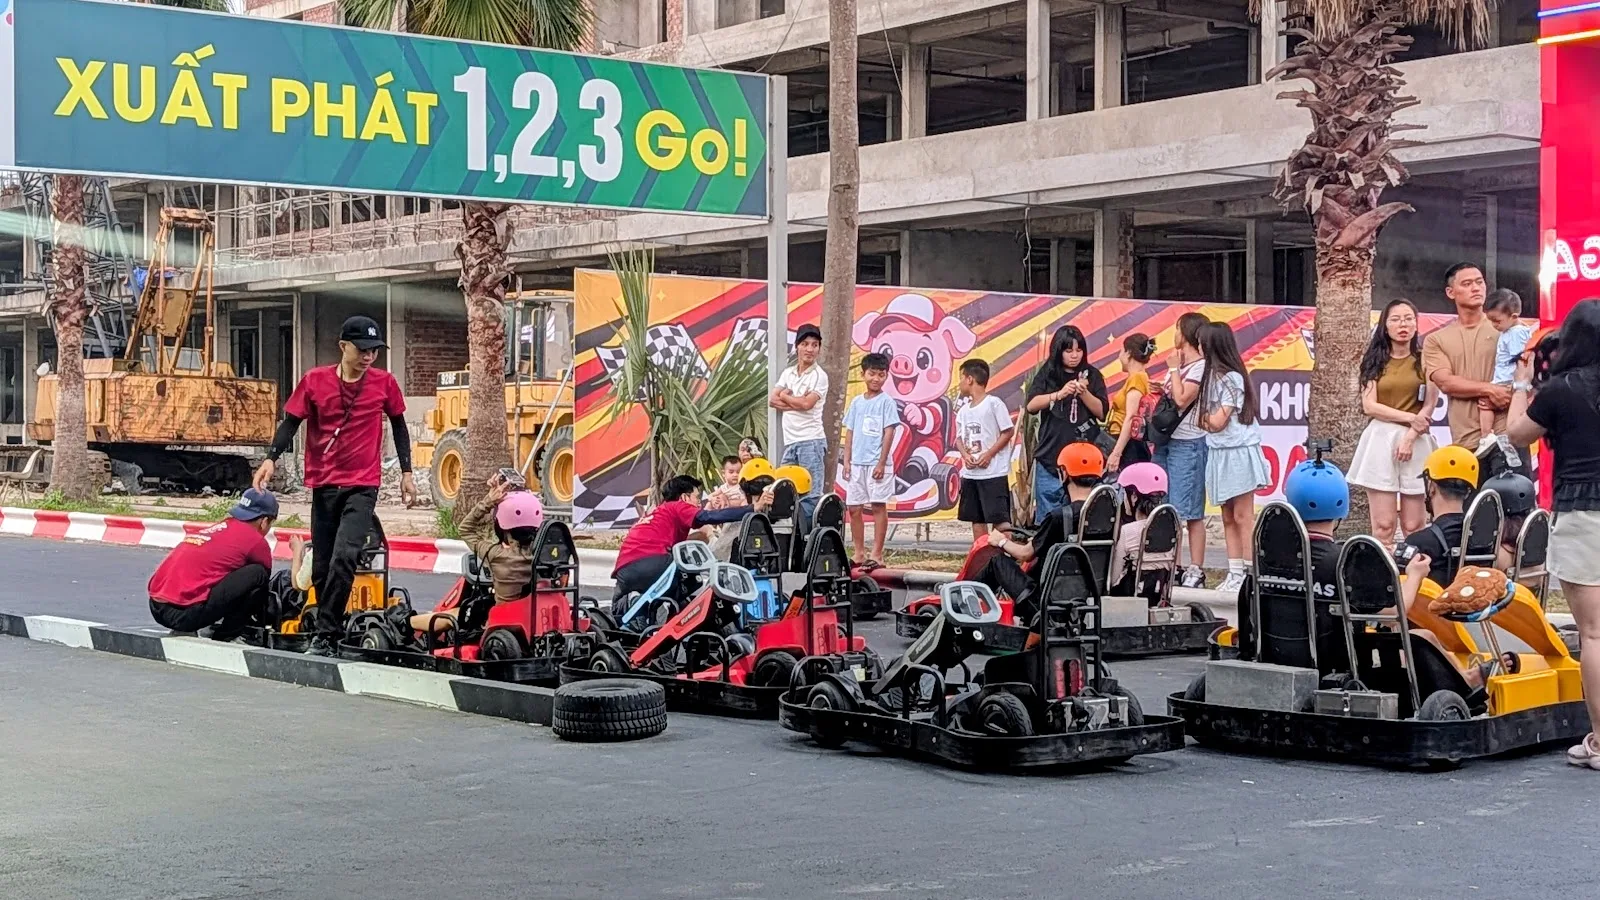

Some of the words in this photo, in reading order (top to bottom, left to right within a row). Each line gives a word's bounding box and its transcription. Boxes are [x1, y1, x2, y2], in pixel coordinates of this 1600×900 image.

[53, 43, 248, 130] XUẤT
[271, 71, 438, 145] PHÁT
[453, 66, 623, 188] 1,2,3
[635, 109, 747, 177] Go!
[754, 538, 761, 548] 3
[551, 547, 558, 558] 4
[824, 560, 829, 572] 1
